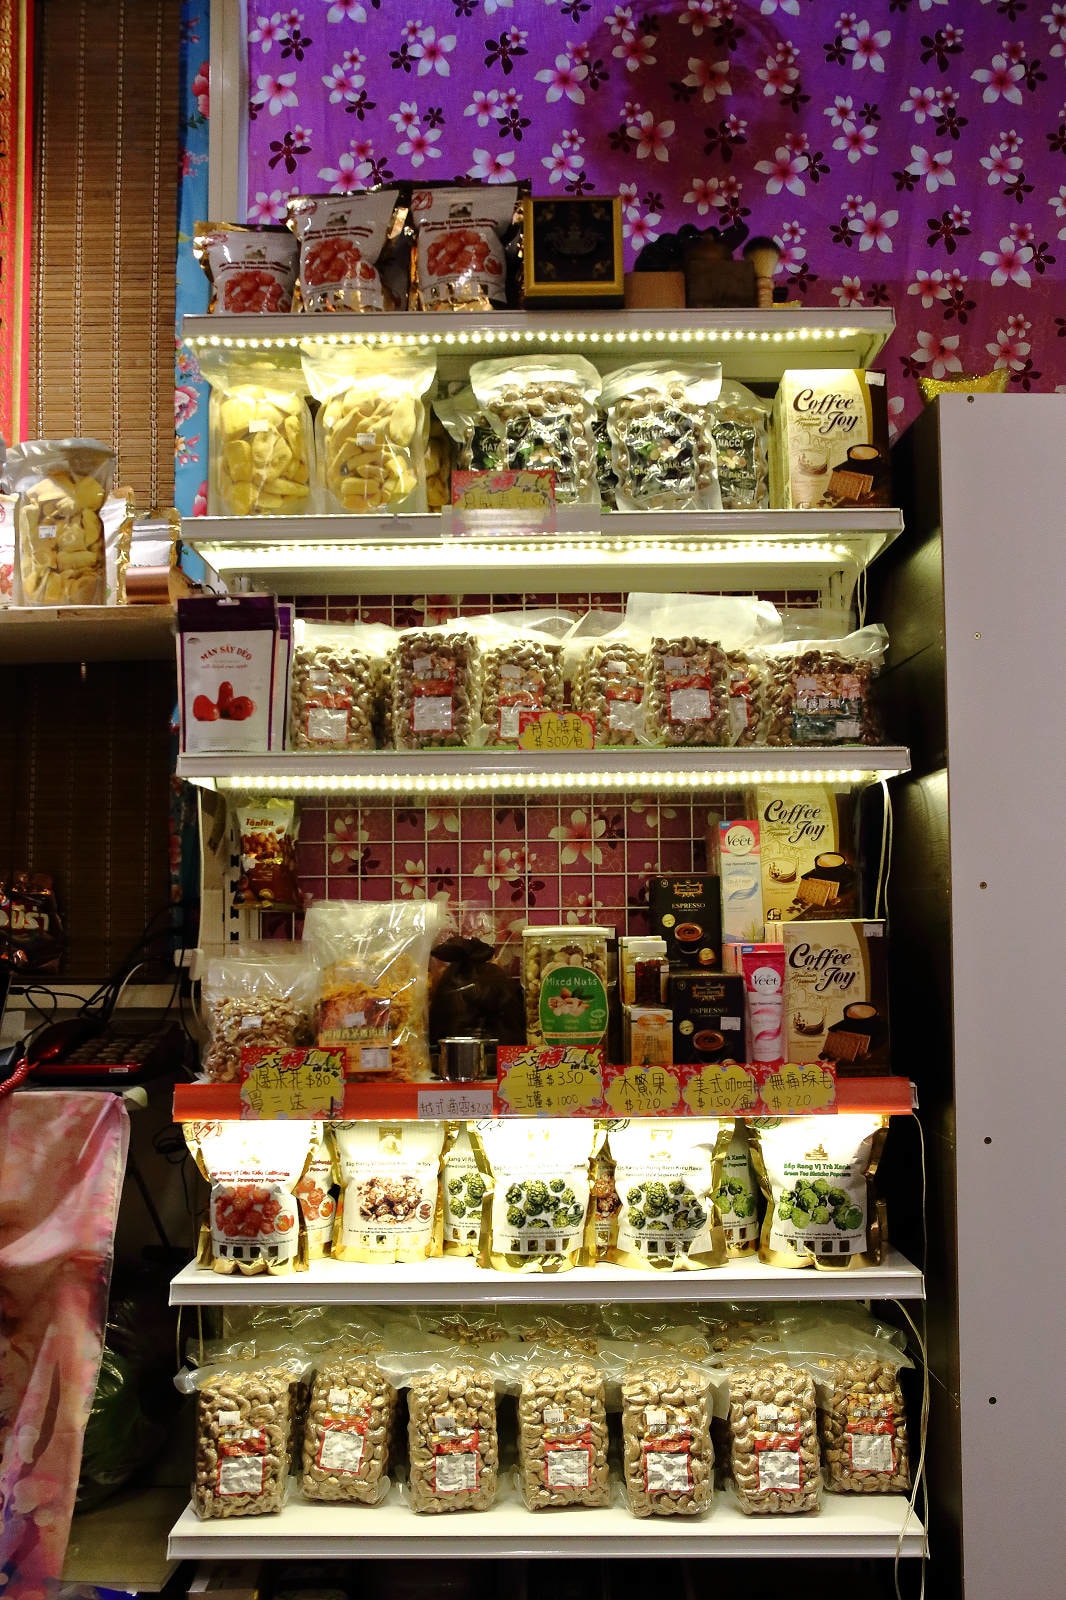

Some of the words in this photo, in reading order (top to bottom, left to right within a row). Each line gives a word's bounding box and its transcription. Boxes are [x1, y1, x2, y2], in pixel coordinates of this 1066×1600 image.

[793, 389, 854, 415] Coffee
[818, 411, 859, 434] Joy
[764, 799, 821, 824] Coffee
[788, 820, 826, 843] Joy
[727, 834, 752, 847] Veet
[671, 902, 706, 910] ESPRESSO
[788, 943, 852, 971] Coffee
[545, 977, 572, 987] Mixed
[573, 977, 598, 986] Nuts
[752, 974, 778, 986] Veet
[815, 967, 856, 992] Joy
[306, 1073, 331, 1089] $80
[546, 1071, 584, 1086] $350
[546, 1093, 580, 1107] $1000
[624, 1098, 661, 1112] $220
[772, 1094, 812, 1110] $220
